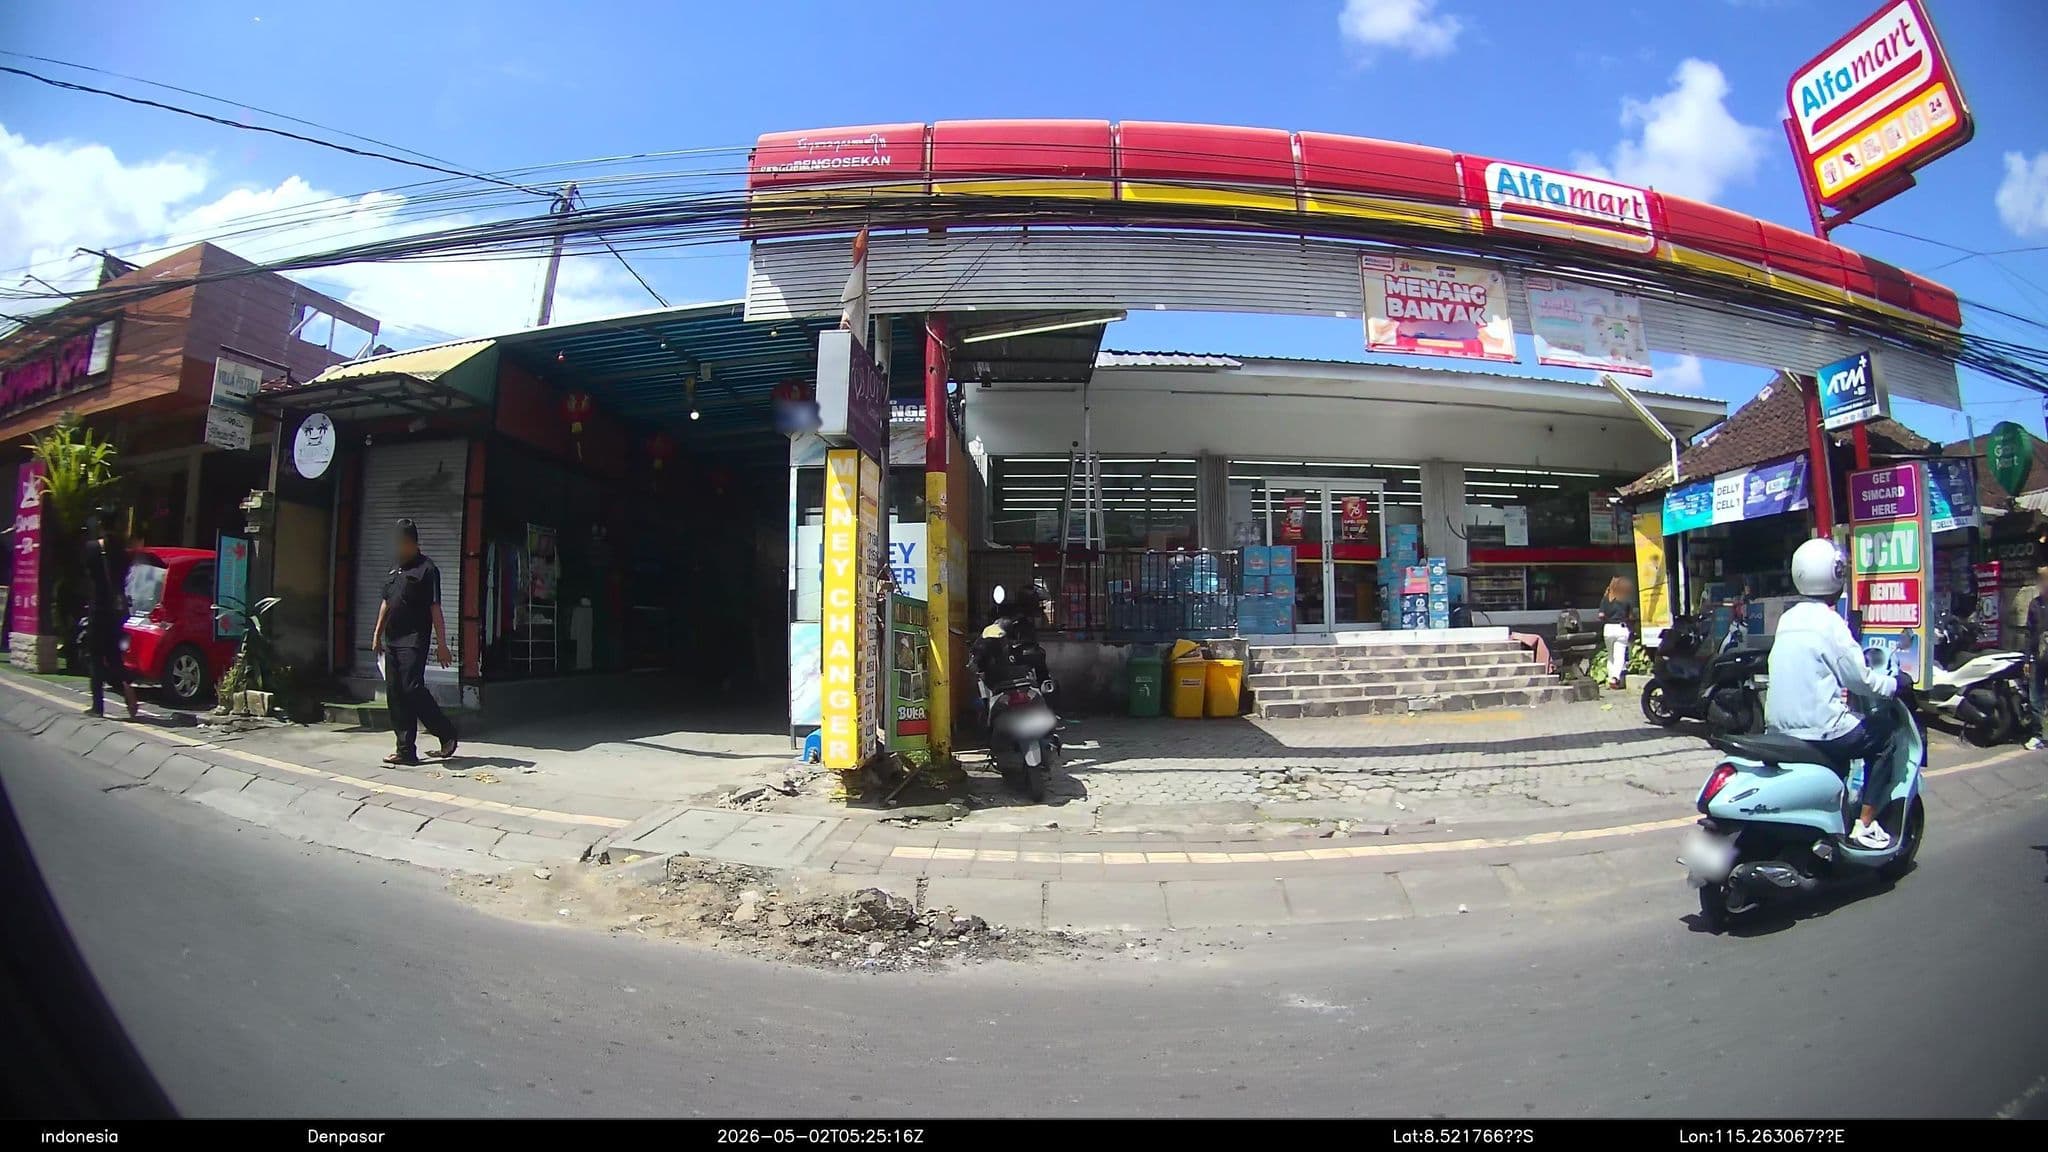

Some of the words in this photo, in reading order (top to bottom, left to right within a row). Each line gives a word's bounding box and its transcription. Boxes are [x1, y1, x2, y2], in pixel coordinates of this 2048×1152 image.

[1801, 18, 1916, 118] Alfamart
[1928, 98, 1943, 113] 24
[1497, 167, 1644, 220] Alfamart
[1385, 274, 1487, 306] MENANG
[1386, 296, 1488, 327] BANYAK
[1716, 483, 1740, 497] DELLY
[1861, 485, 1905, 502] SIMCARD
[1872, 472, 1891, 484] GET
[831, 457, 855, 577] MONEY
[1871, 503, 1898, 516] HERE
[1860, 529, 1914, 568] CCTV
[1869, 582, 1906, 601] RENTAL
[828, 587, 853, 760] CHANGER
